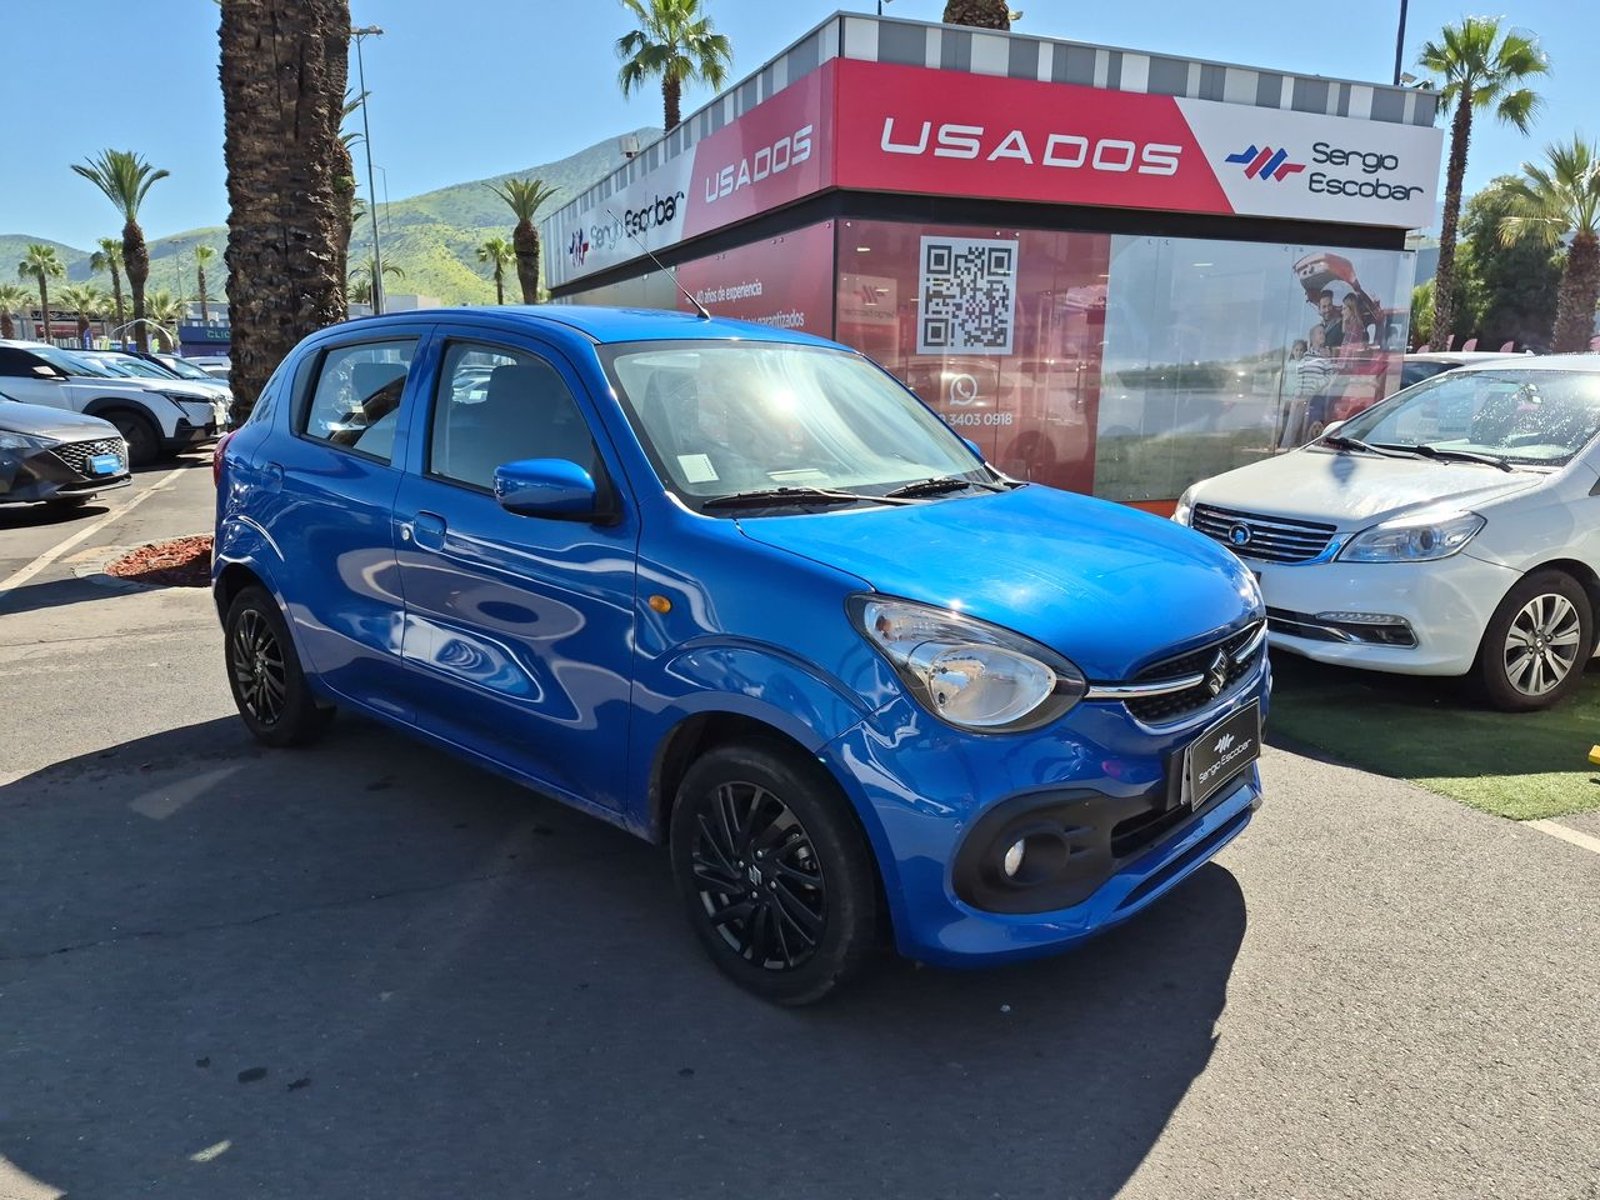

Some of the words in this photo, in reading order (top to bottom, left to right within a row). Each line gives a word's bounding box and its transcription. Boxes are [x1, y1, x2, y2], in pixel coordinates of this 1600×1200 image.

[880, 116, 1183, 177] USADOS
[1311, 141, 1399, 174] Sergio
[705, 124, 813, 203] USADOS
[1308, 171, 1425, 201] Escobar
[624, 190, 685, 238] Escobar
[704, 288, 717, 303] años
[718, 285, 726, 301] de
[726, 279, 763, 302] experiencia
[949, 413, 981, 425] 3403
[984, 413, 1013, 425] 0918
[1221, 739, 1252, 765] Escobar
